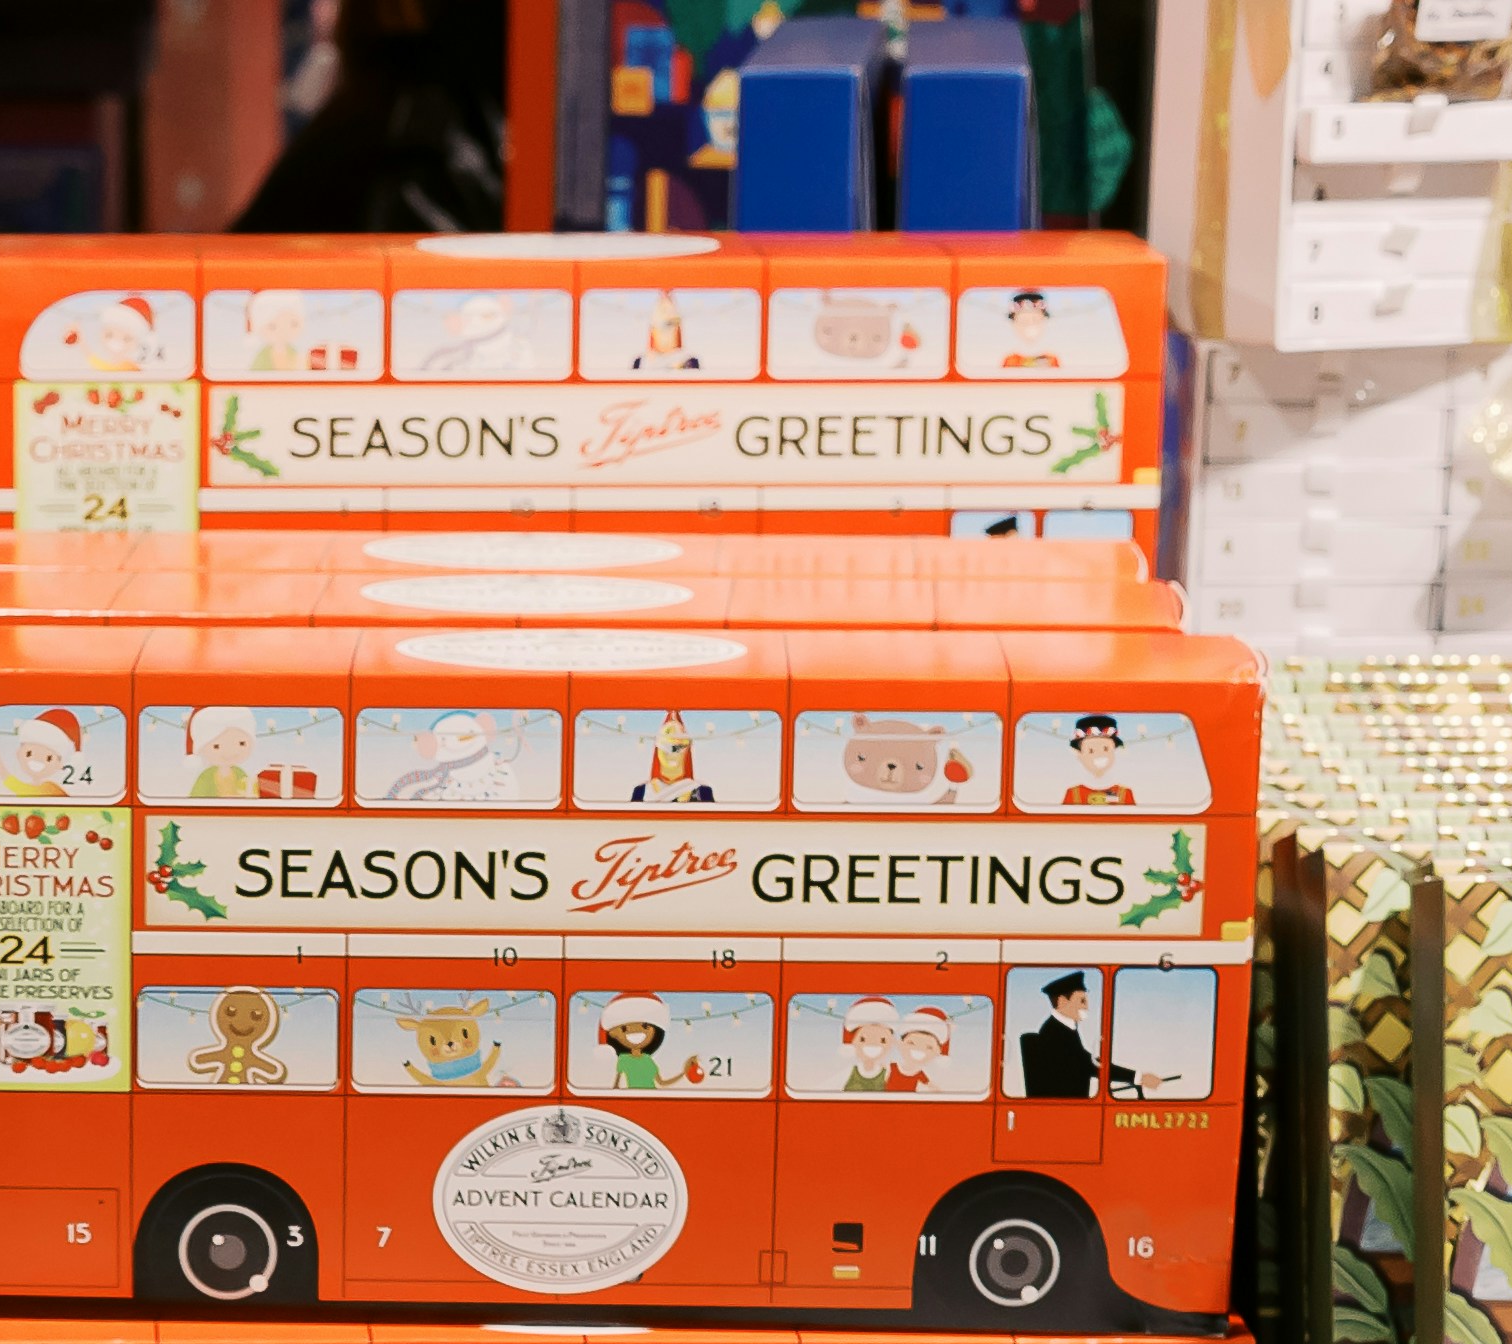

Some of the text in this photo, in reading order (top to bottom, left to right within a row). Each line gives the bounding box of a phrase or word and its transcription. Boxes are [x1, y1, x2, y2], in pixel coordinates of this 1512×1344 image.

[289, 415, 560, 460] SEASON'S
[734, 414, 1053, 459] GREETINGS
[83, 494, 128, 522] 24
[62, 765, 93, 785] 24
[234, 835, 1126, 914] SEASON'S Tiptree GREETINGS
[491, 947, 518, 967] 10
[711, 950, 737, 970] 18
[935, 952, 949, 971] 2
[13, 968, 54, 982] JARS
[59, 968, 80, 982] OF
[14, 985, 114, 1000] PRESERVES
[708, 1058, 733, 1078] 21
[461, 1127, 520, 1173] WILKIN
[585, 1124, 631, 1153] SONS
[632, 1147, 661, 1177] LTD
[453, 1189, 669, 1210] ADVENT CALENDAR
[67, 1223, 92, 1244] 15
[286, 1226, 304, 1248] 3
[377, 1227, 392, 1249] 7
[1128, 1236, 1154, 1259] 16
